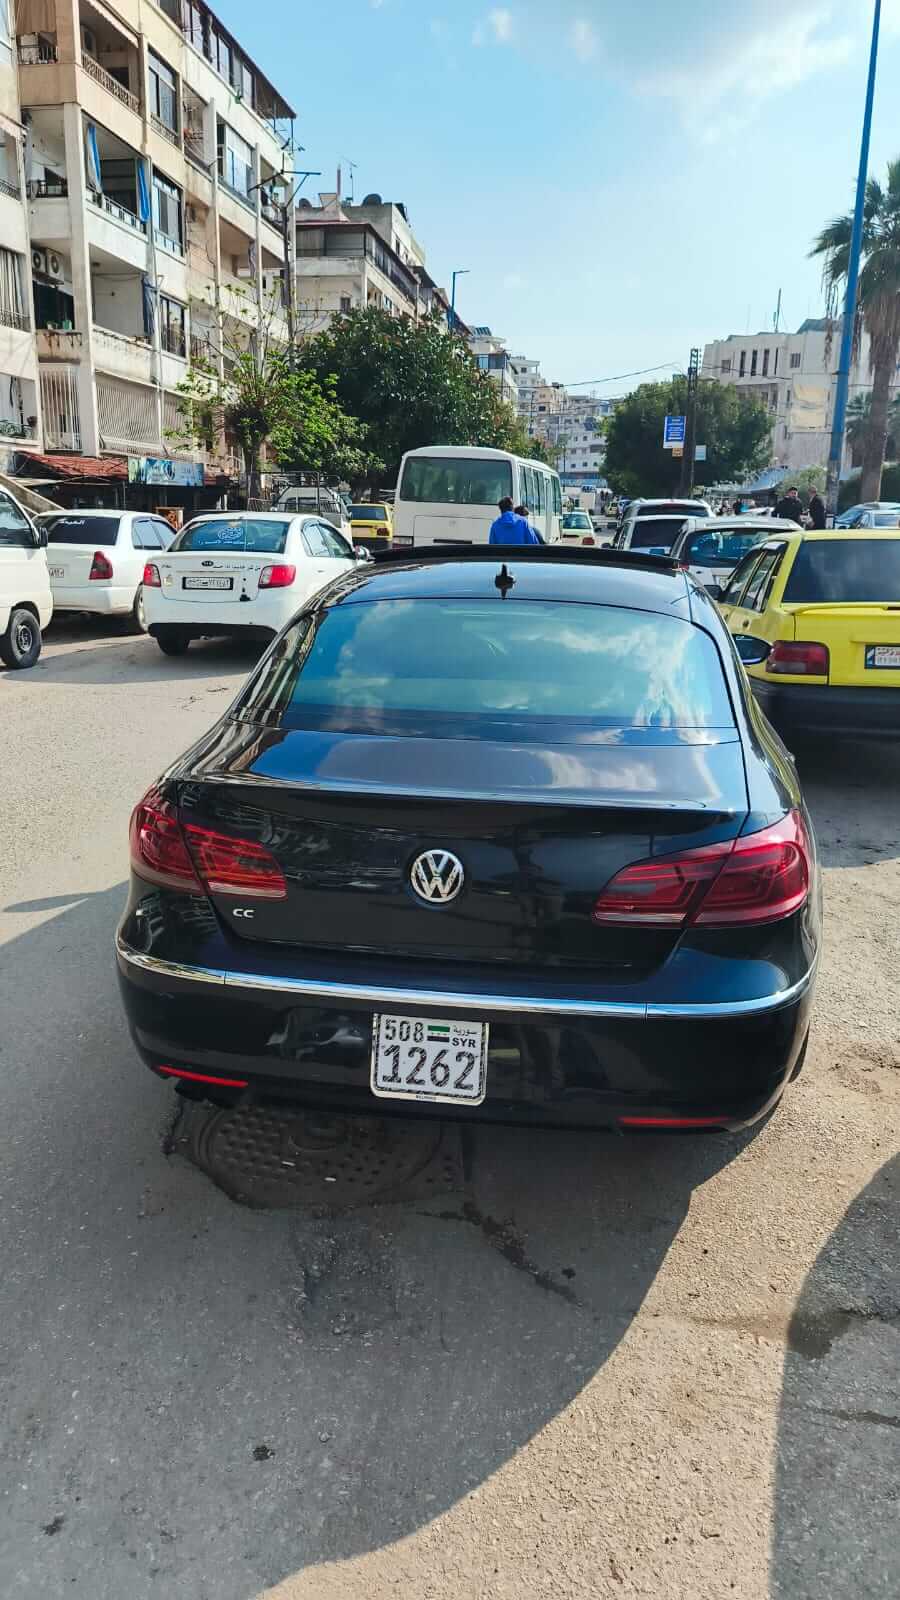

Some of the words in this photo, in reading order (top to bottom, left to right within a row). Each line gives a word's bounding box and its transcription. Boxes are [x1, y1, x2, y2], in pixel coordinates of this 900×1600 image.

[411, 849, 463, 903] VW
[232, 907, 255, 919] CC
[385, 1018, 424, 1042] 508
[452, 1037, 476, 1048] SYR
[382, 1044, 475, 1090] 1262
